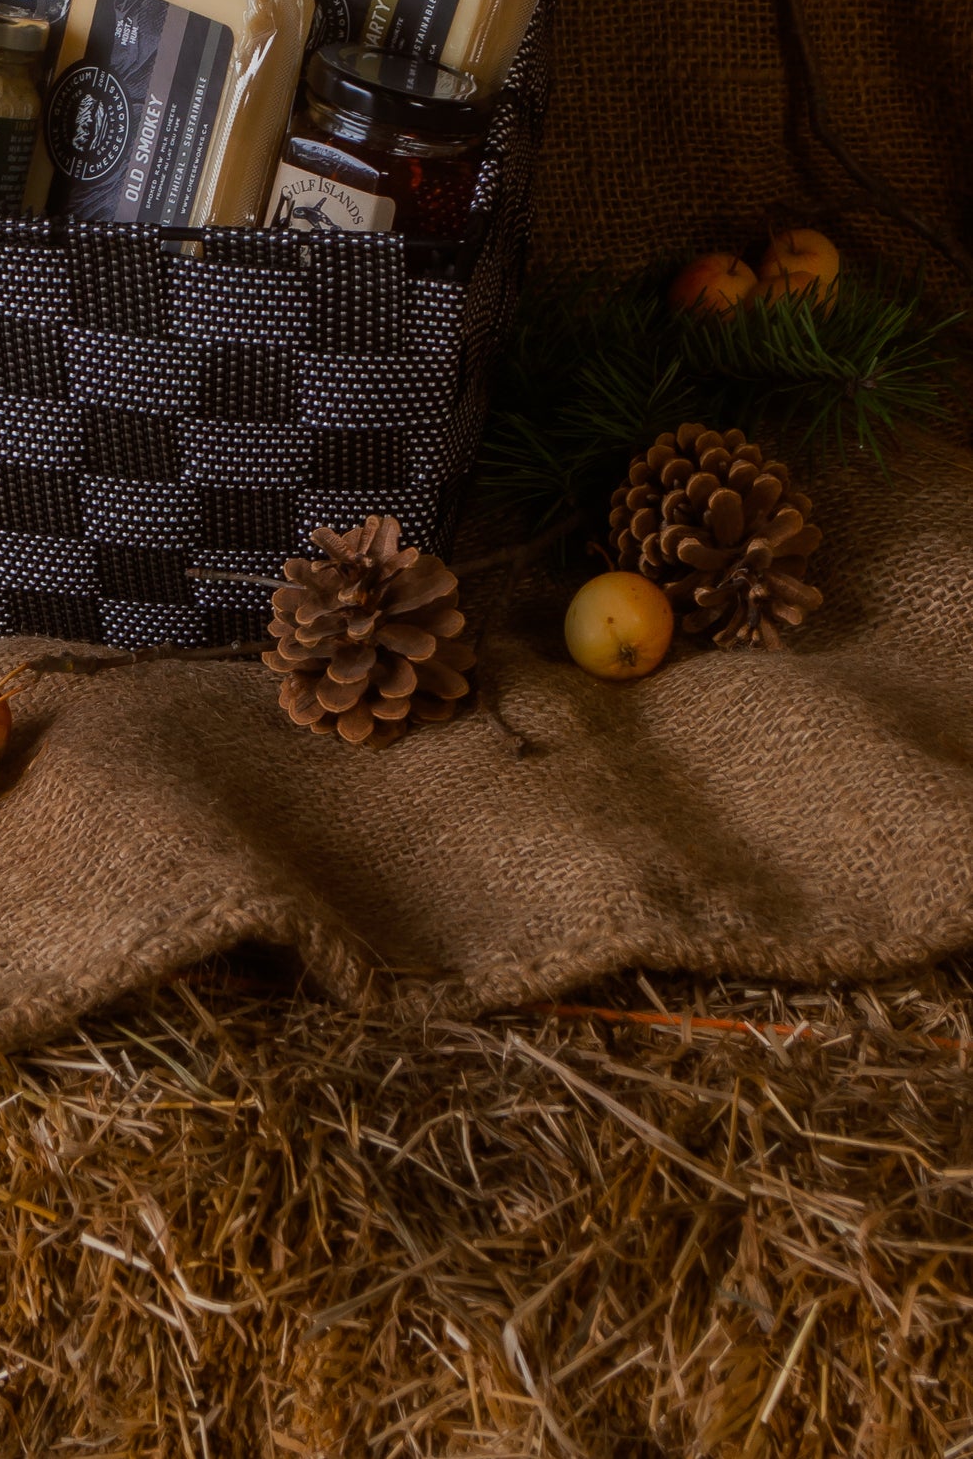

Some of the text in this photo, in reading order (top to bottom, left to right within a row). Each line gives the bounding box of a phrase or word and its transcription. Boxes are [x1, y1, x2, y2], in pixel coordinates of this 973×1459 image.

[54, 71, 92, 116] QUALICUM
[97, 70, 106, 88] 2001
[89, 85, 125, 173] CHEESEWORKS
[125, 93, 164, 202] OLD SMOKEY
[146, 103, 178, 209] SMOKED RAW MILK CHEESE
[168, 77, 207, 204] ETHICAL SUSTAINABLE
[281, 177, 364, 225] GULF ISLANDS
